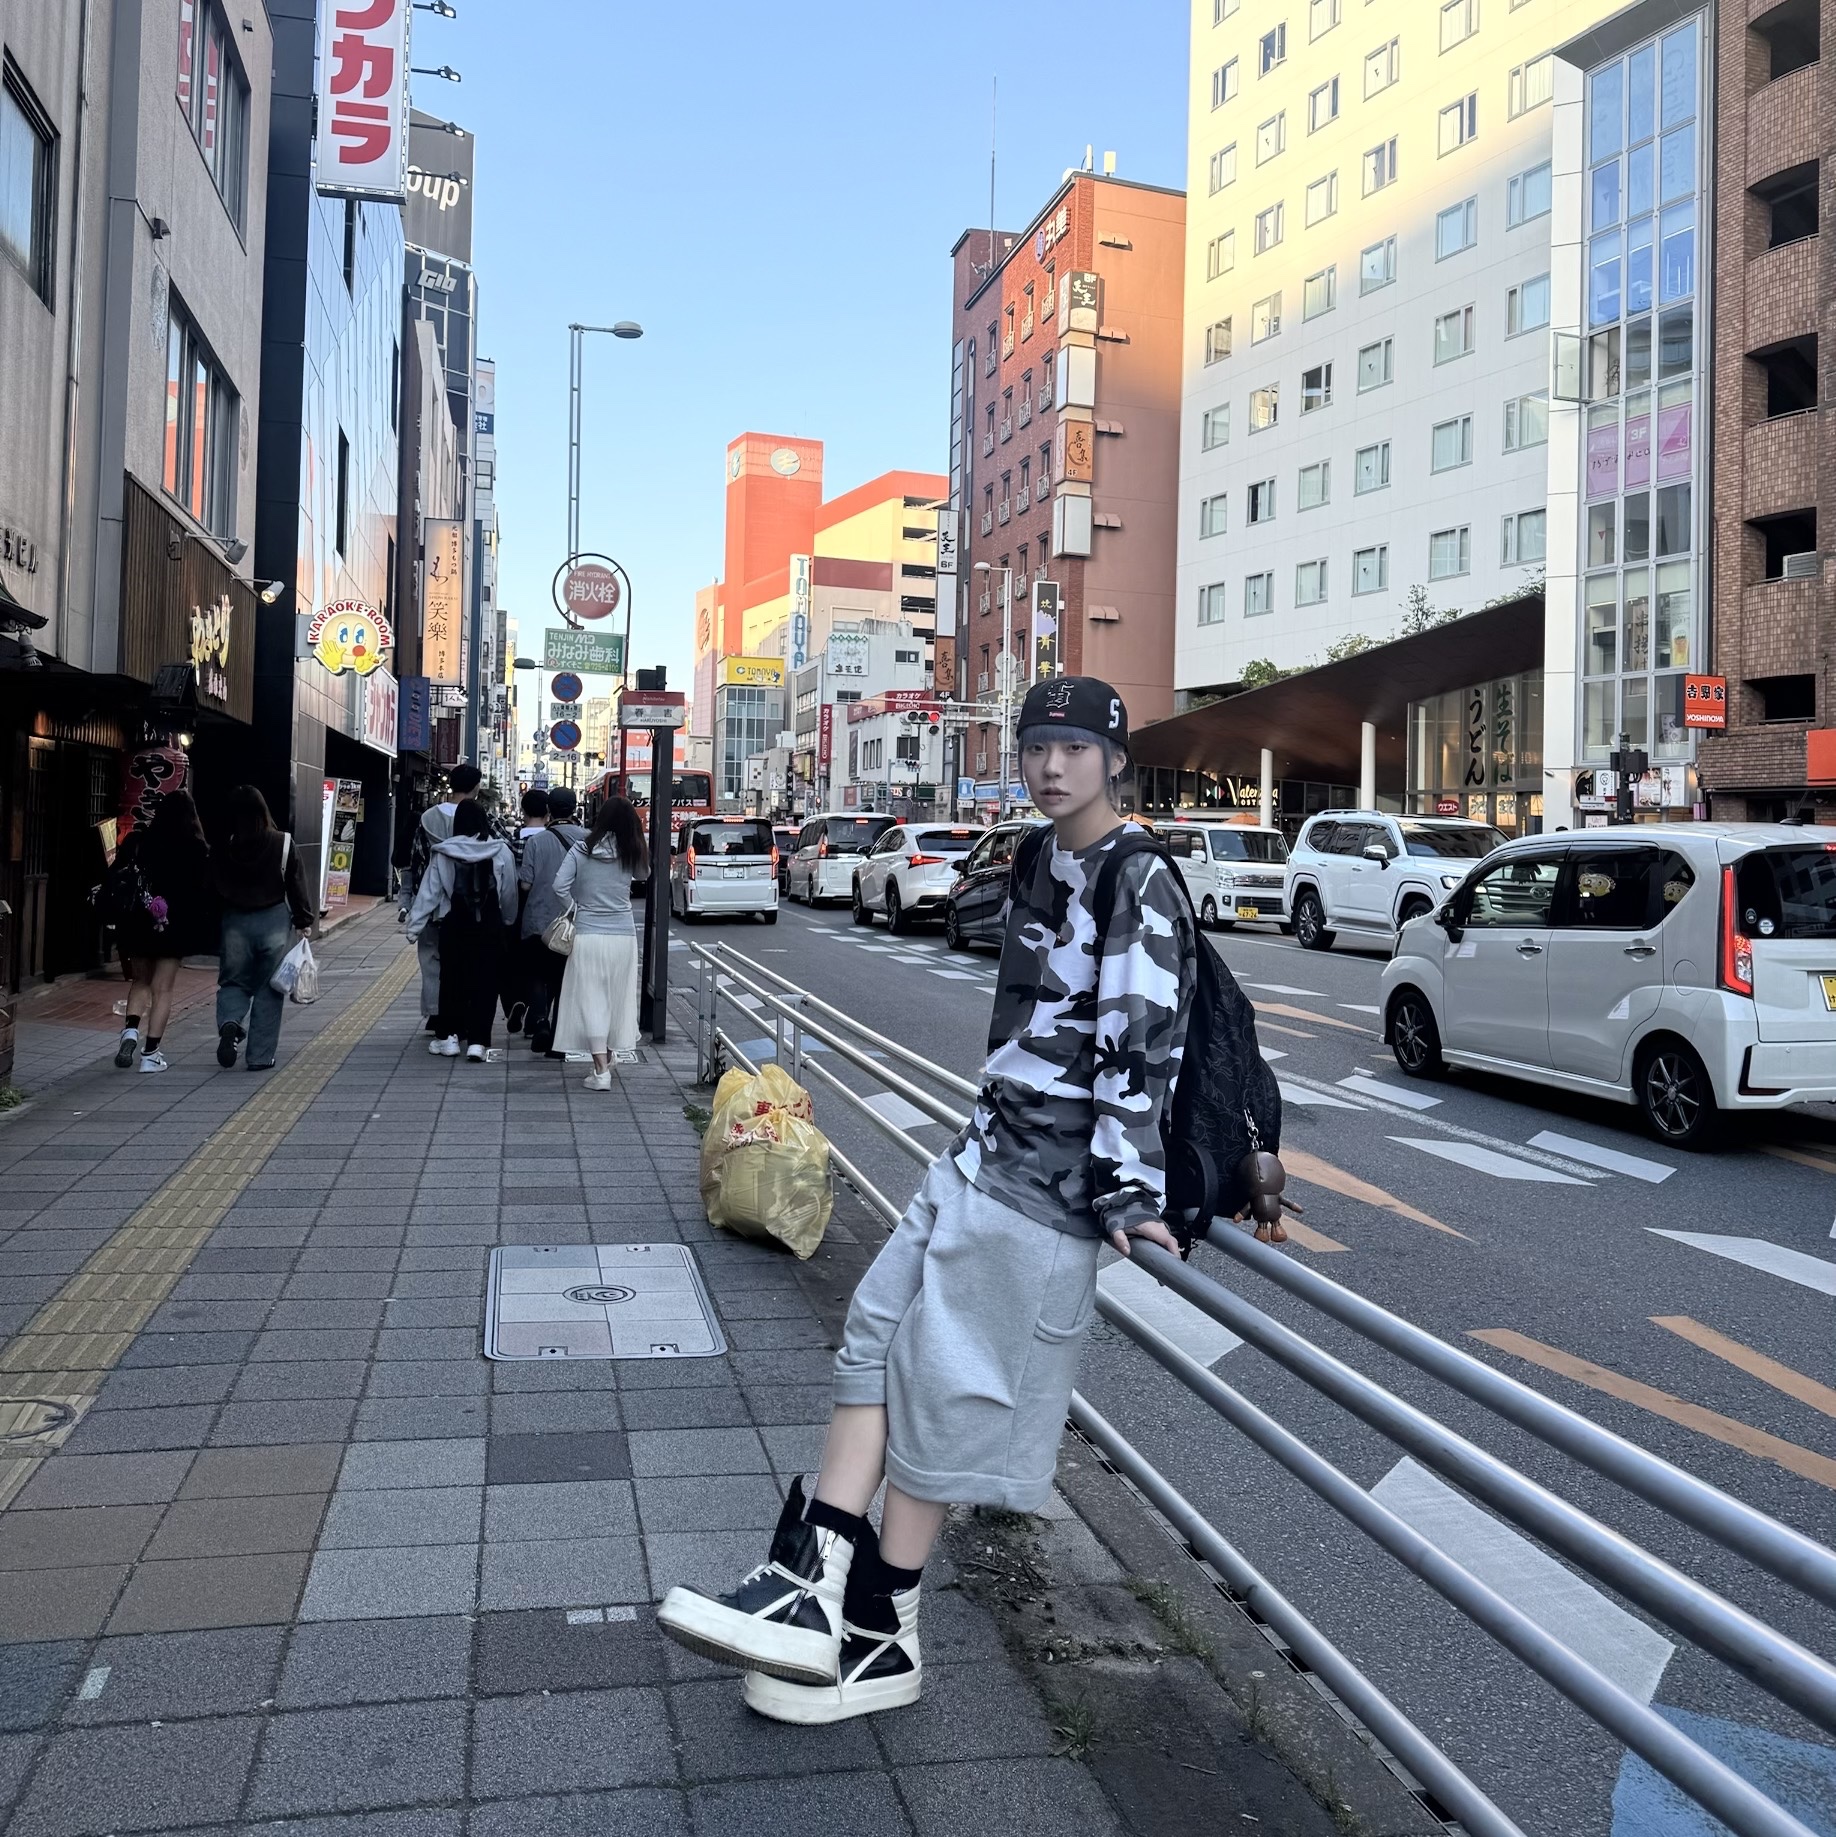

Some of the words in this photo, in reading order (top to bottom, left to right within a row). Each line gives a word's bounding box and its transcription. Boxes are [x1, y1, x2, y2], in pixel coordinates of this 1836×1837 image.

[569, 580, 616, 603] 消火栓
[550, 632, 574, 642] TENJIN
[548, 642, 620, 663] みなみ歯科
[896, 692, 921, 700] カラオケ
[1686, 684, 1725, 701] 吉野家
[1108, 698, 1120, 729] S
[1686, 714, 1725, 723] YOSHINOYA
[1465, 689, 1487, 786] うどん
[1494, 684, 1514, 785] 生そば
[553, 753, 577, 761] 2-16
[1437, 802, 1458, 812] ウエスト
